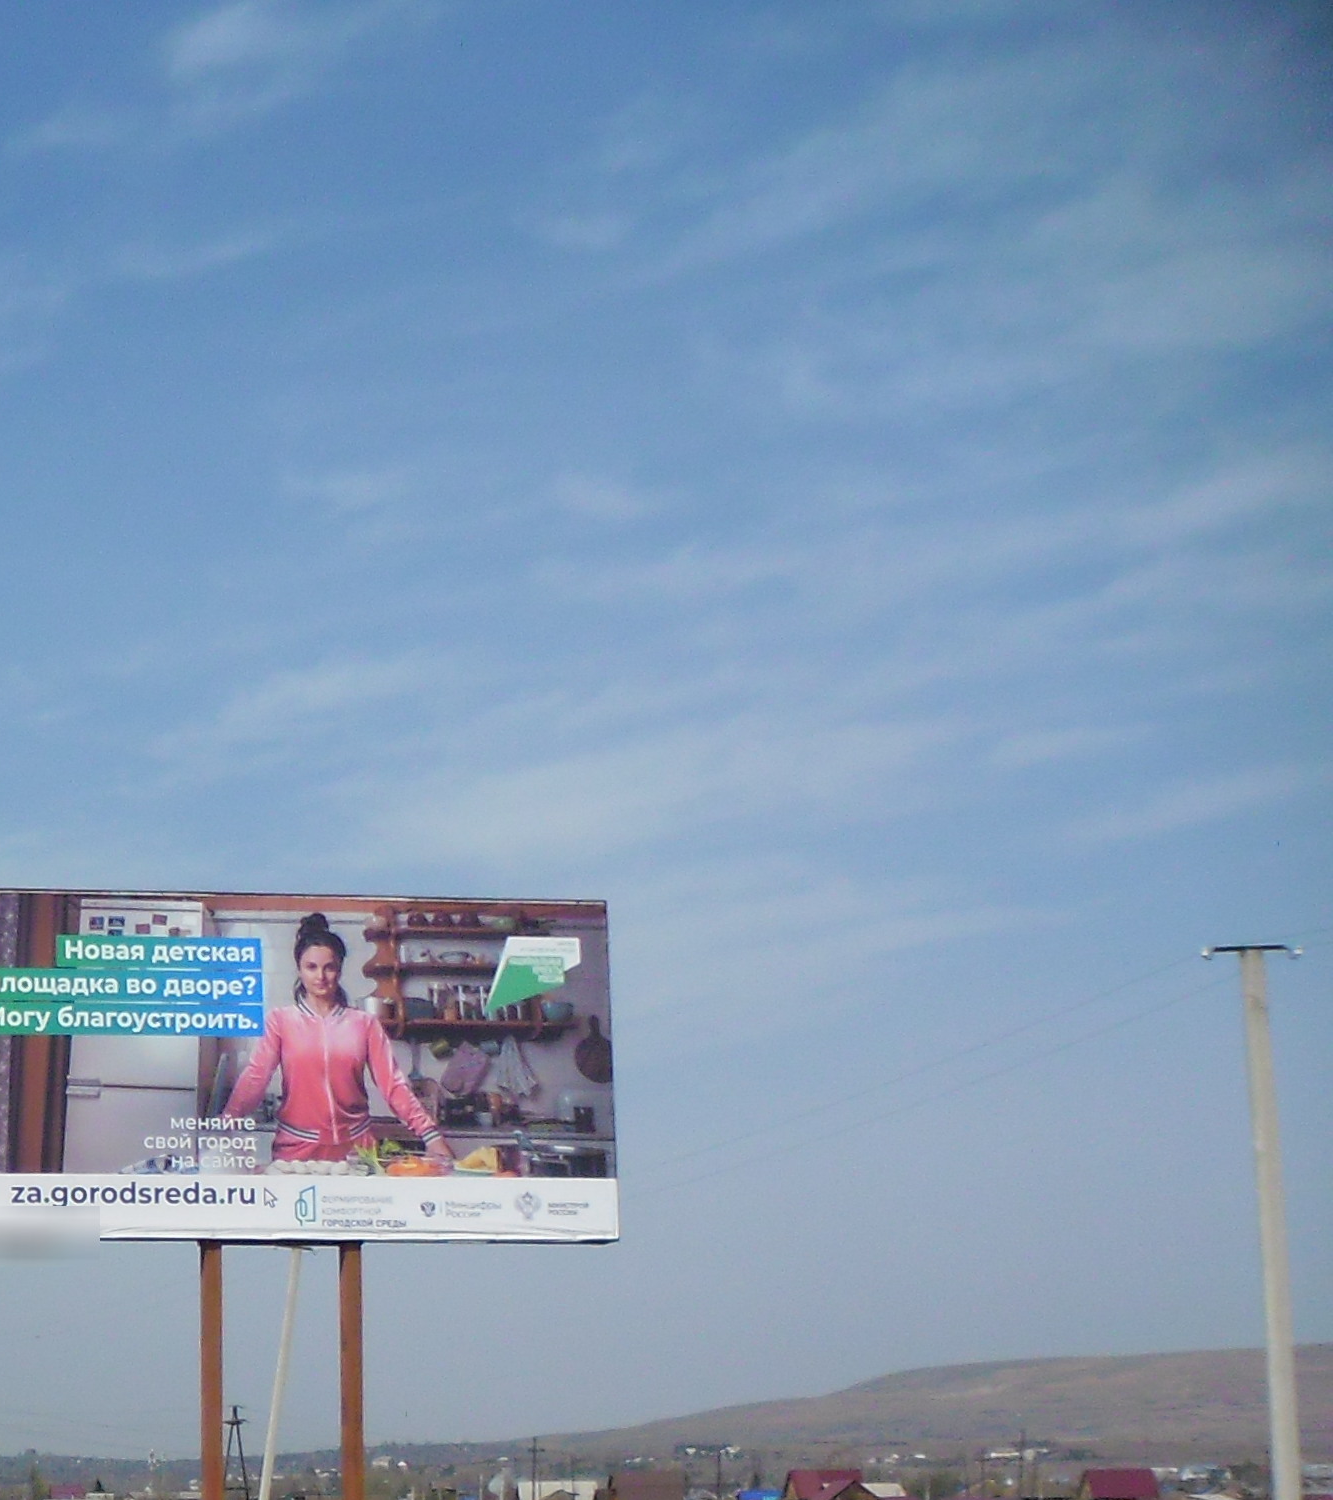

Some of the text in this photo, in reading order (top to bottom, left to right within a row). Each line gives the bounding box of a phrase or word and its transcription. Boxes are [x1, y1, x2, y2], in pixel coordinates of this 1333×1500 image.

[63, 938, 256, 964] Новая детская
[126, 977, 157, 995] во
[162, 974, 257, 1000] дворе?
[57, 1005, 259, 1034] благоустроить.
[169, 1115, 256, 1131] меняйте
[143, 1134, 257, 1153] свой город
[170, 1153, 256, 1169] на сайте
[10, 1181, 256, 1207] za.gorodsreda.ru
[321, 1217, 407, 1228] ГОРОДСКОЙ СРЕДЫ
